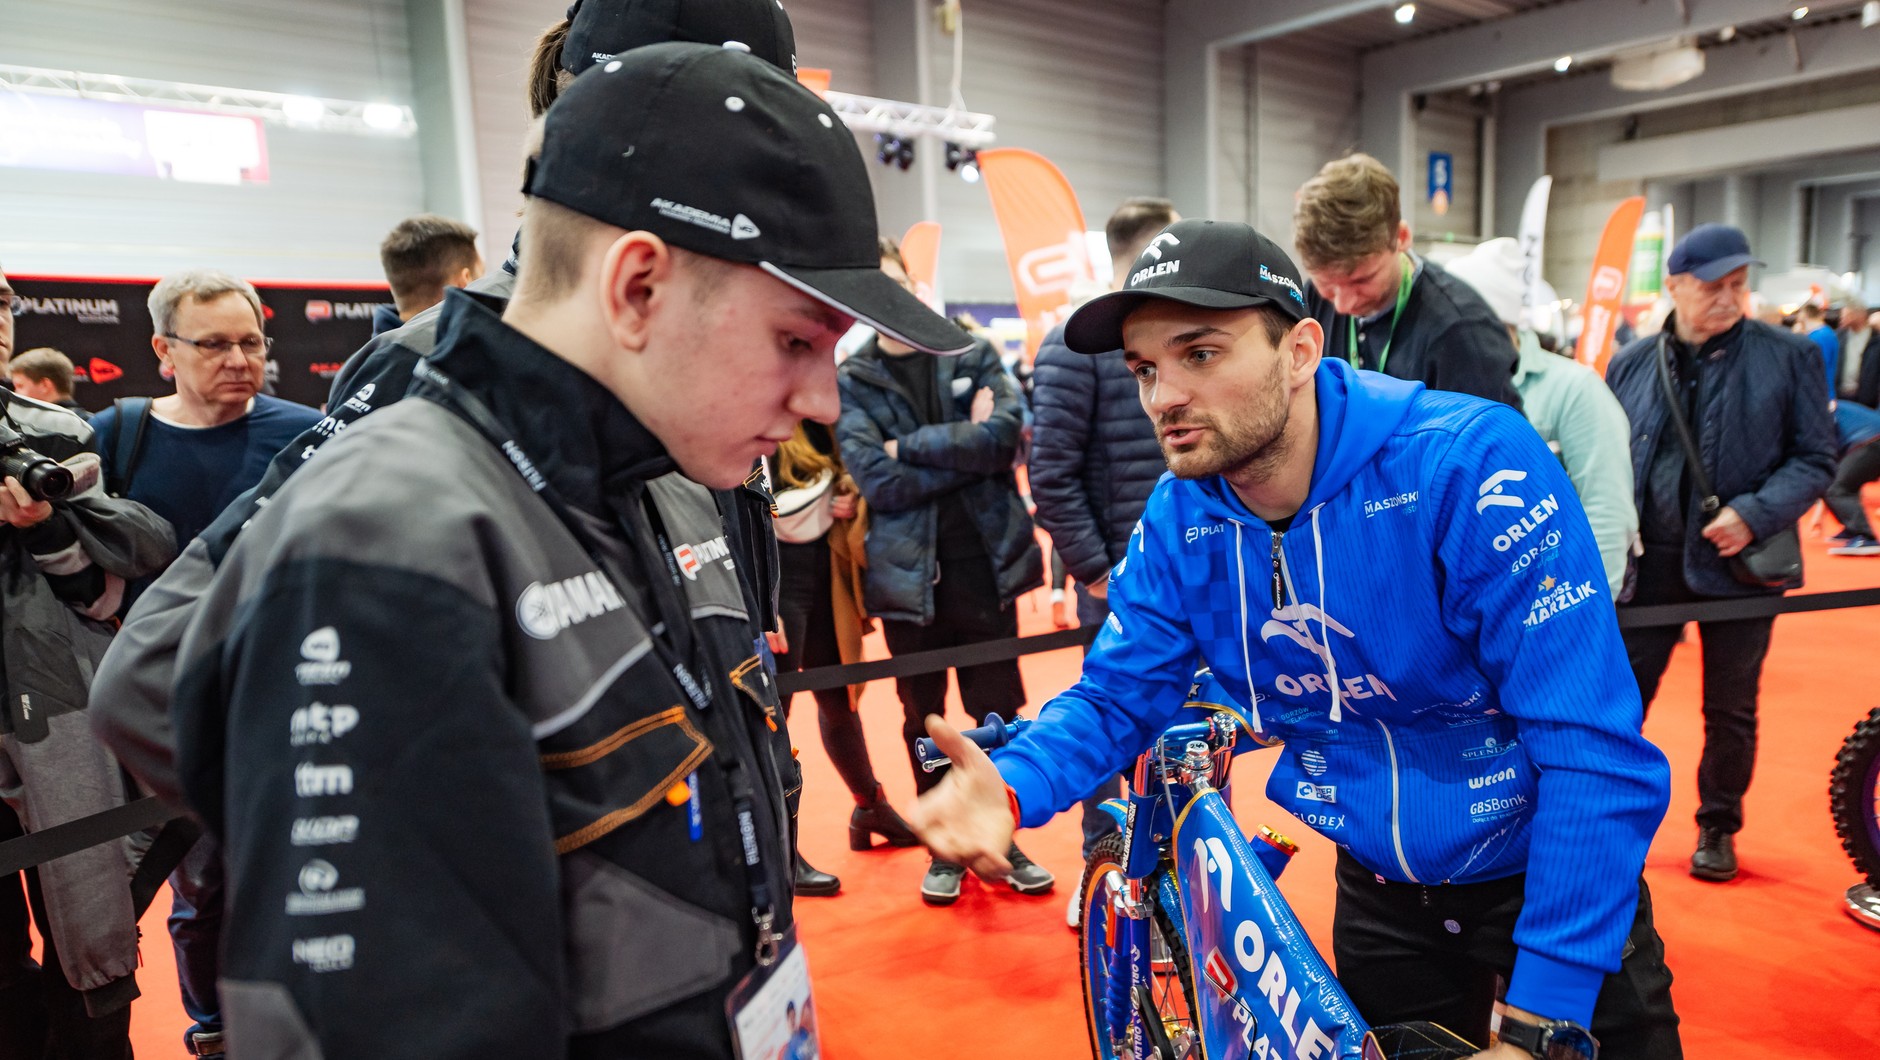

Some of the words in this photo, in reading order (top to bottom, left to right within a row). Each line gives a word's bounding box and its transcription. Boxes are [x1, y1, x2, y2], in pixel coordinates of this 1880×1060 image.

[591, 52, 617, 60] AKAD
[1131, 259, 1180, 287] ORLEN
[1493, 494, 1560, 552] ORLEN
[1275, 673, 1398, 702] ORLEN
[1468, 767, 1516, 789] wecon
[1234, 919, 1338, 1060] ORLE
